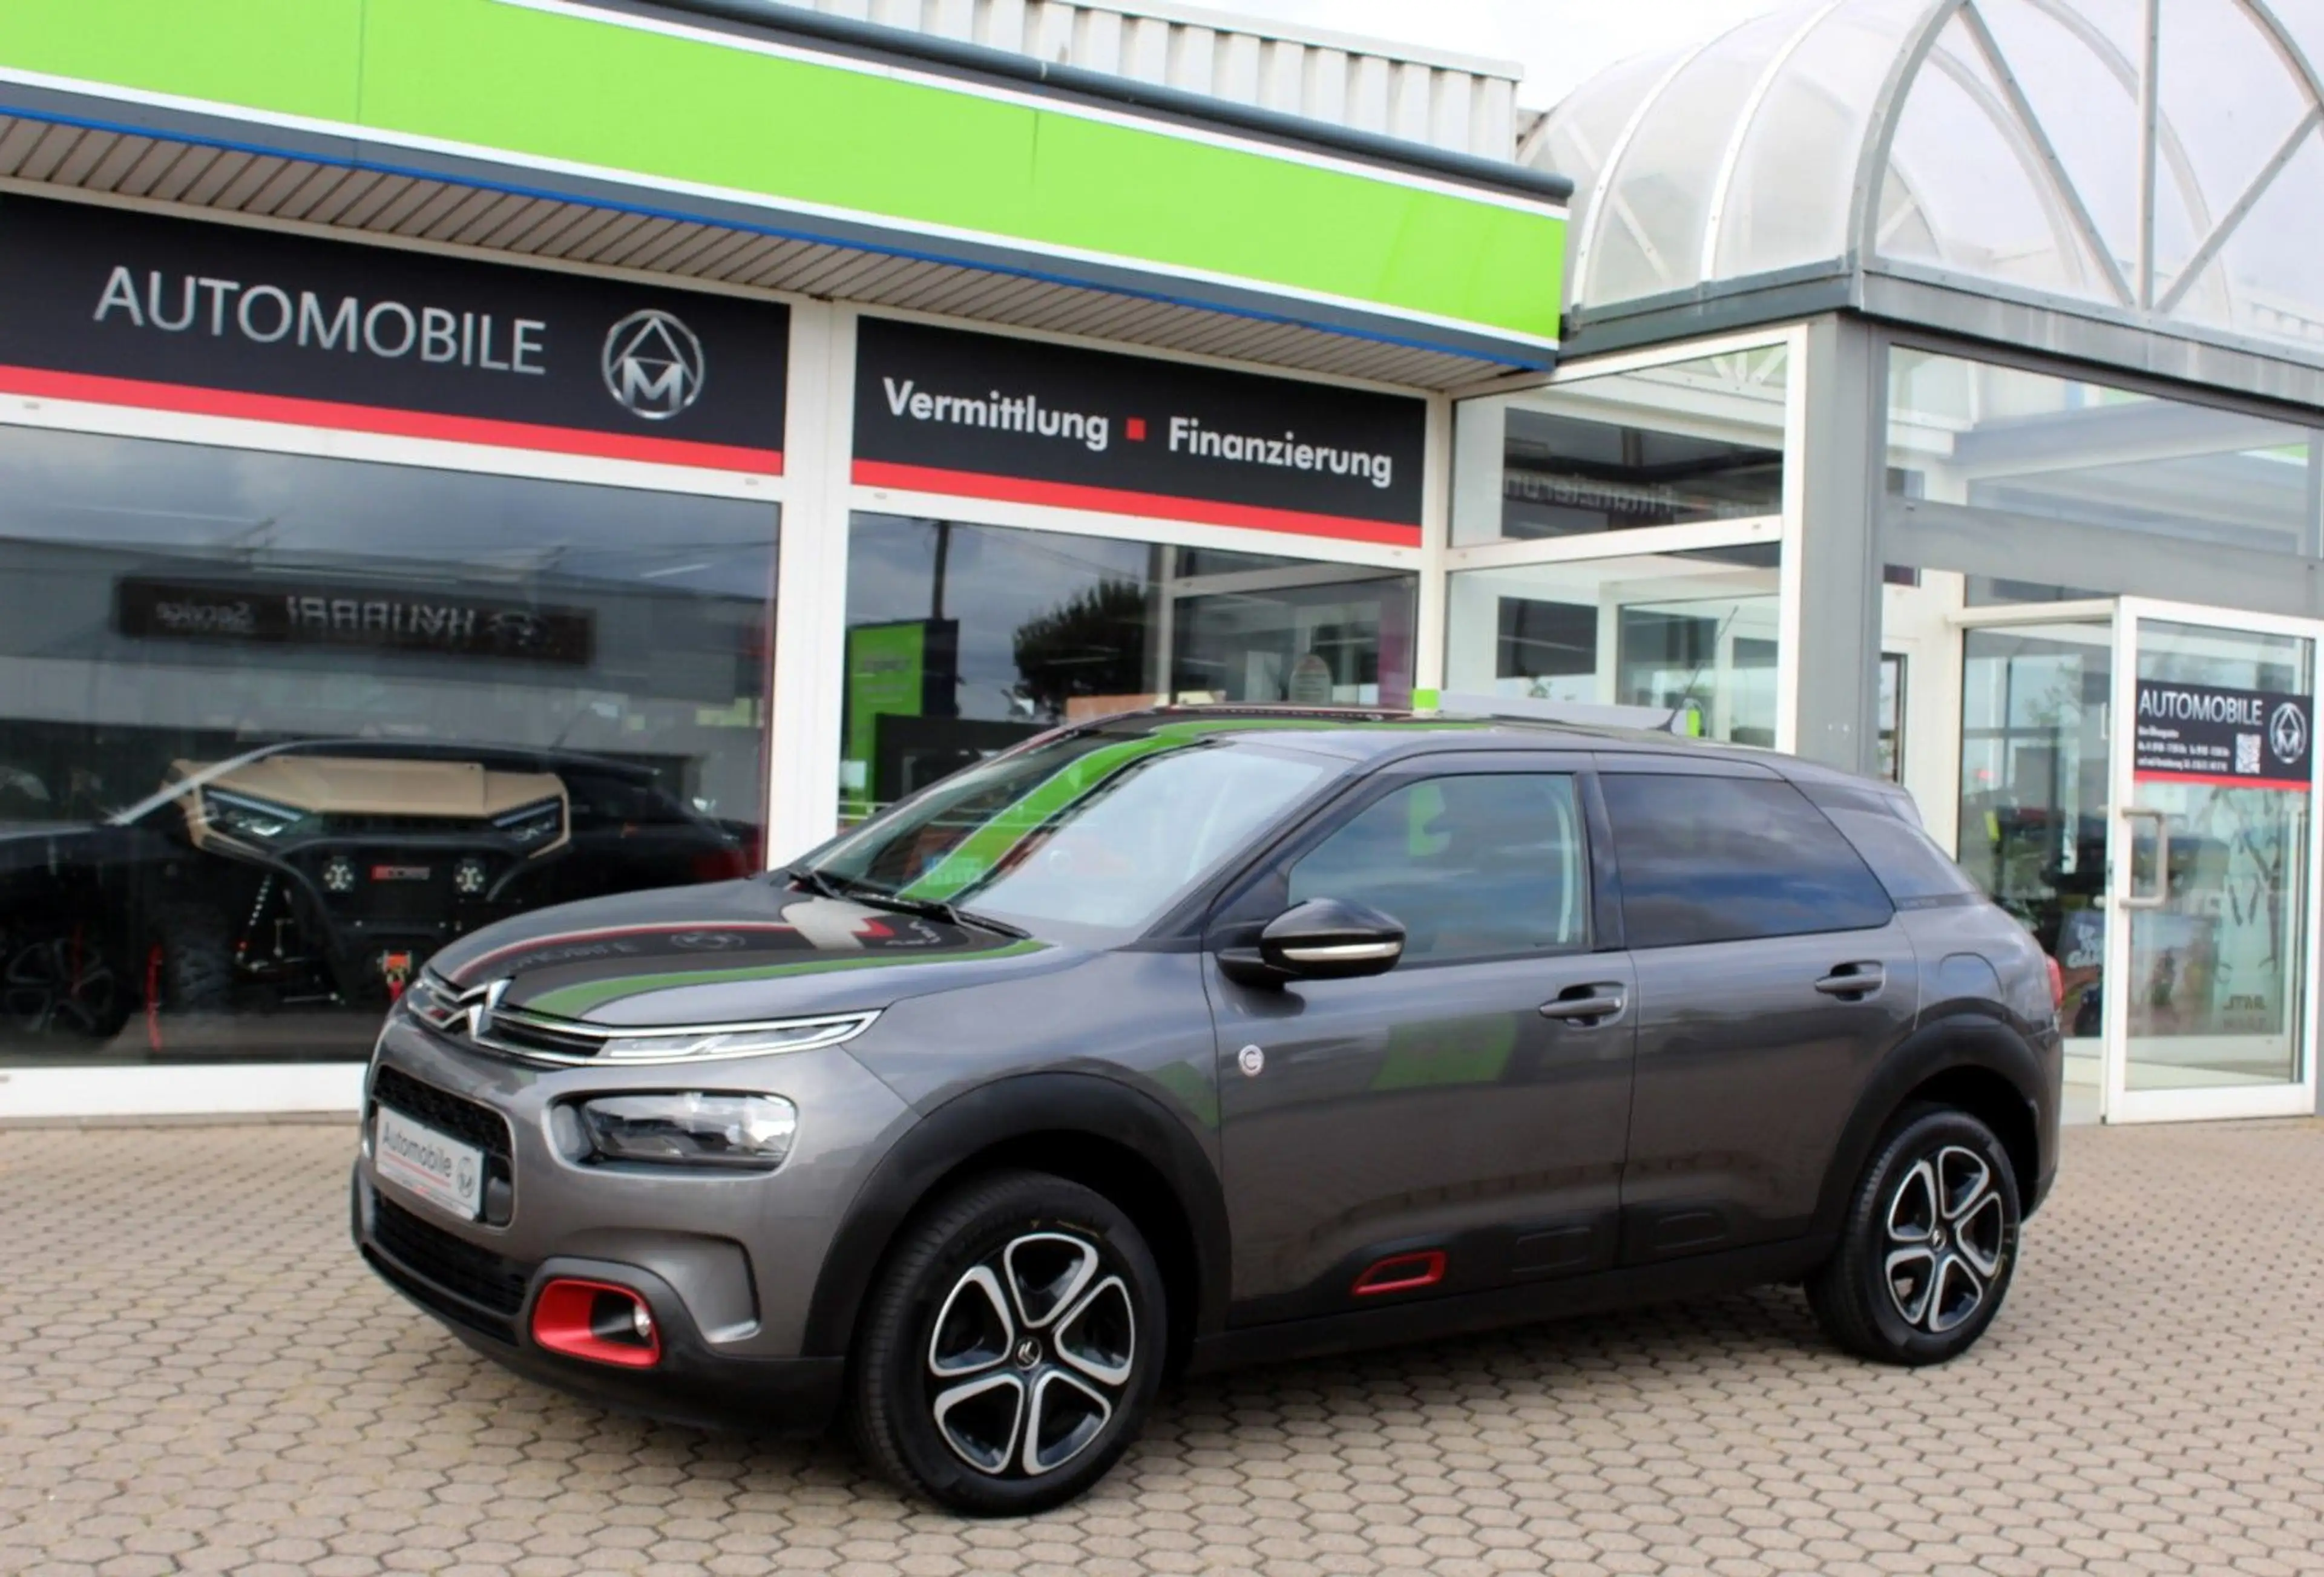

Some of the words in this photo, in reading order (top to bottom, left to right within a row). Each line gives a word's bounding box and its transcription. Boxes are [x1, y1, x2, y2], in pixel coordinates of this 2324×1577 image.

[93, 266, 546, 375] AUTOMOBILE
[883, 377, 1109, 451] Vermittlung
[1169, 416, 1393, 488] Finanzierung
[2138, 689, 2263, 726] AUTOMOBILE
